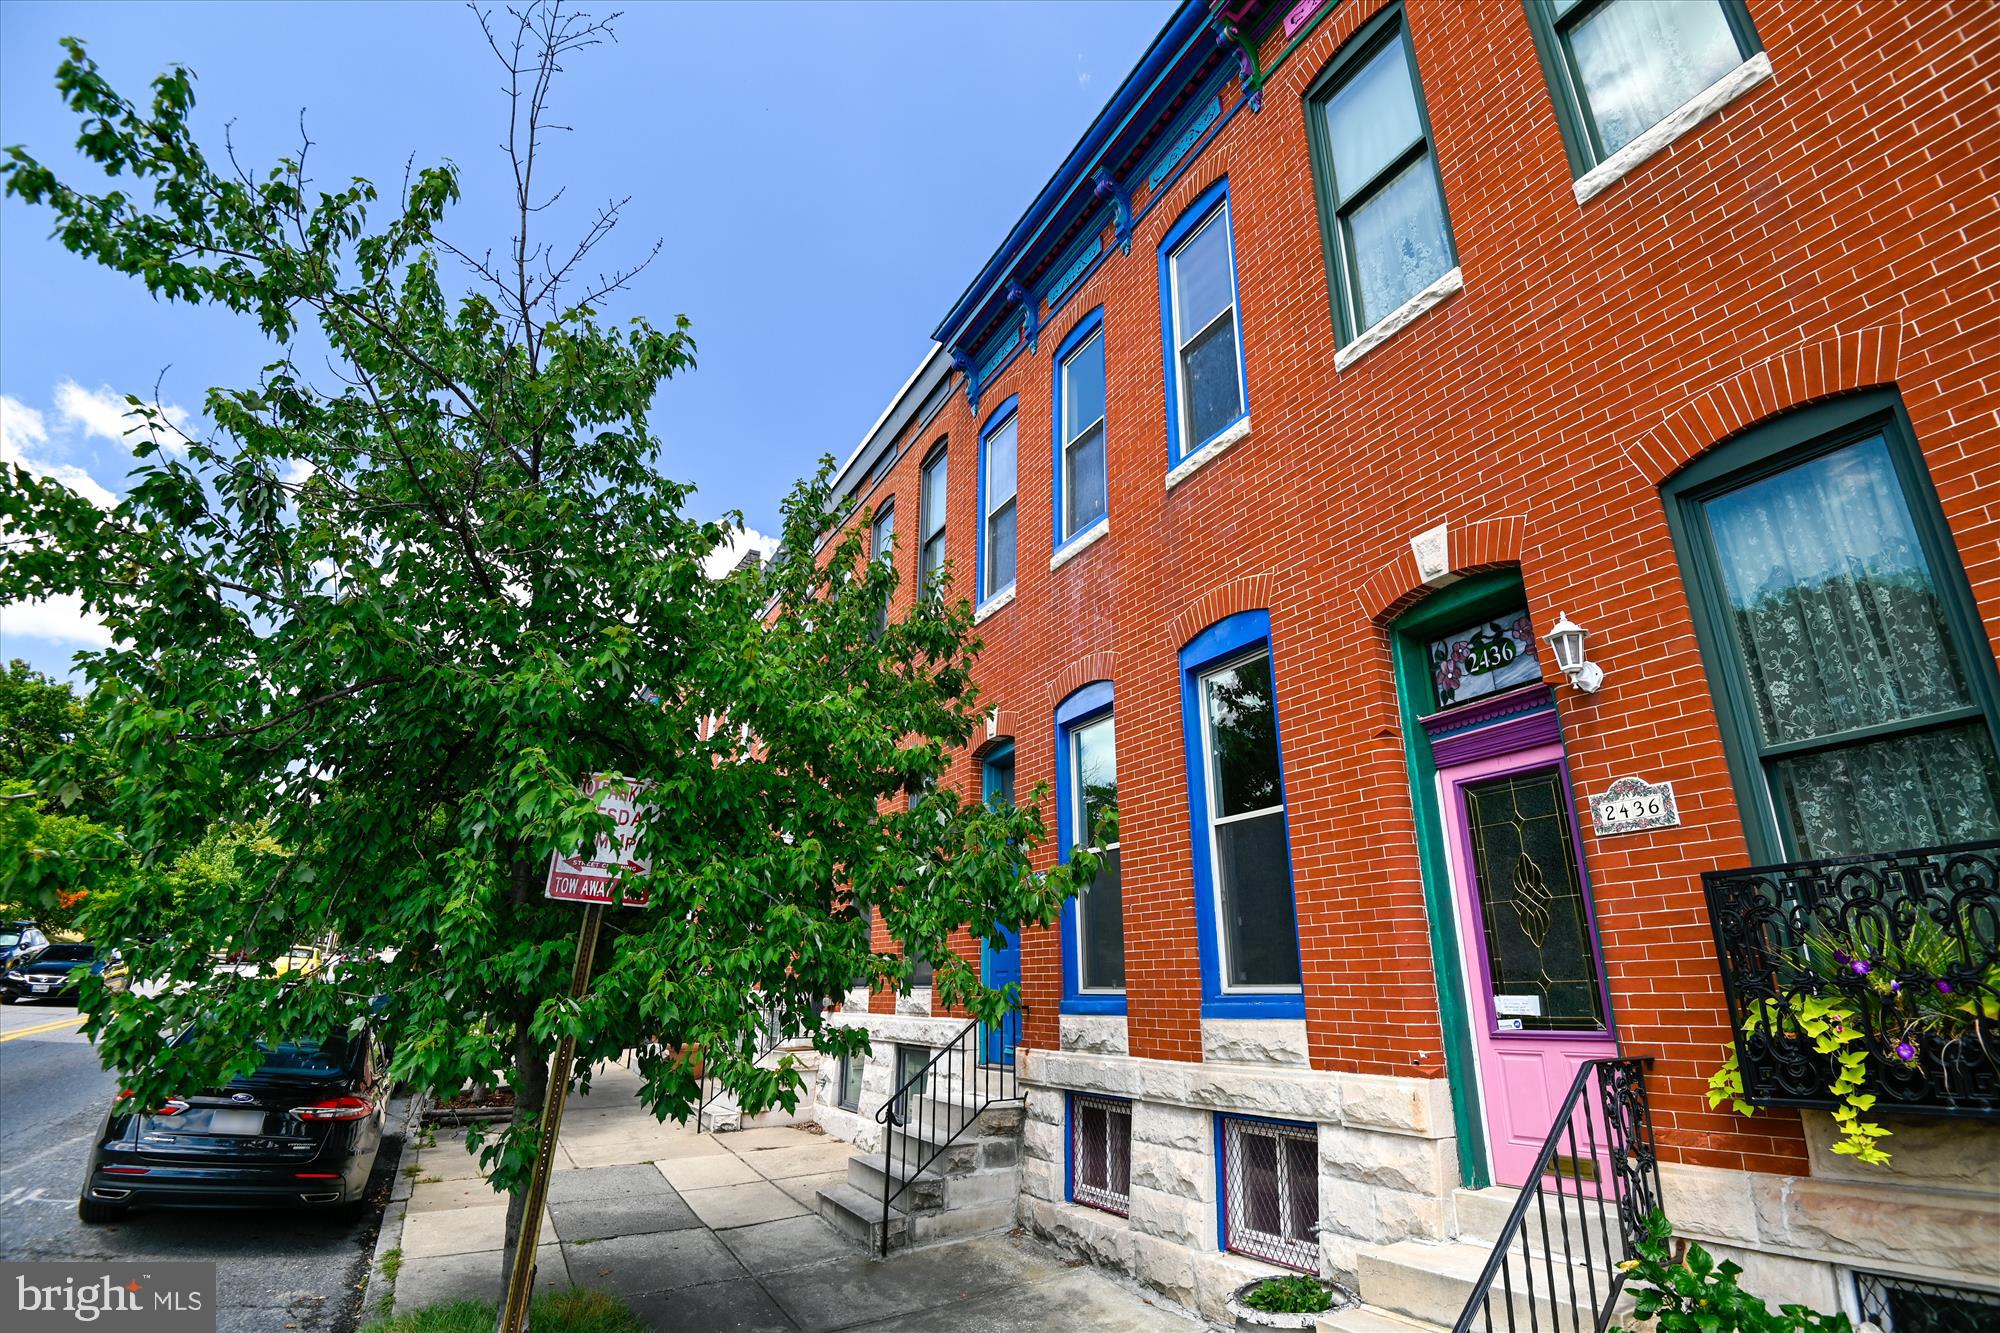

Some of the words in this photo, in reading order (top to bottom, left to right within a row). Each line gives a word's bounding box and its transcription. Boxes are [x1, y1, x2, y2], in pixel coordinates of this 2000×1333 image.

[1467, 642, 1514, 673] 2436
[1605, 798, 1660, 821] 2436
[555, 877, 579, 894] TOW
